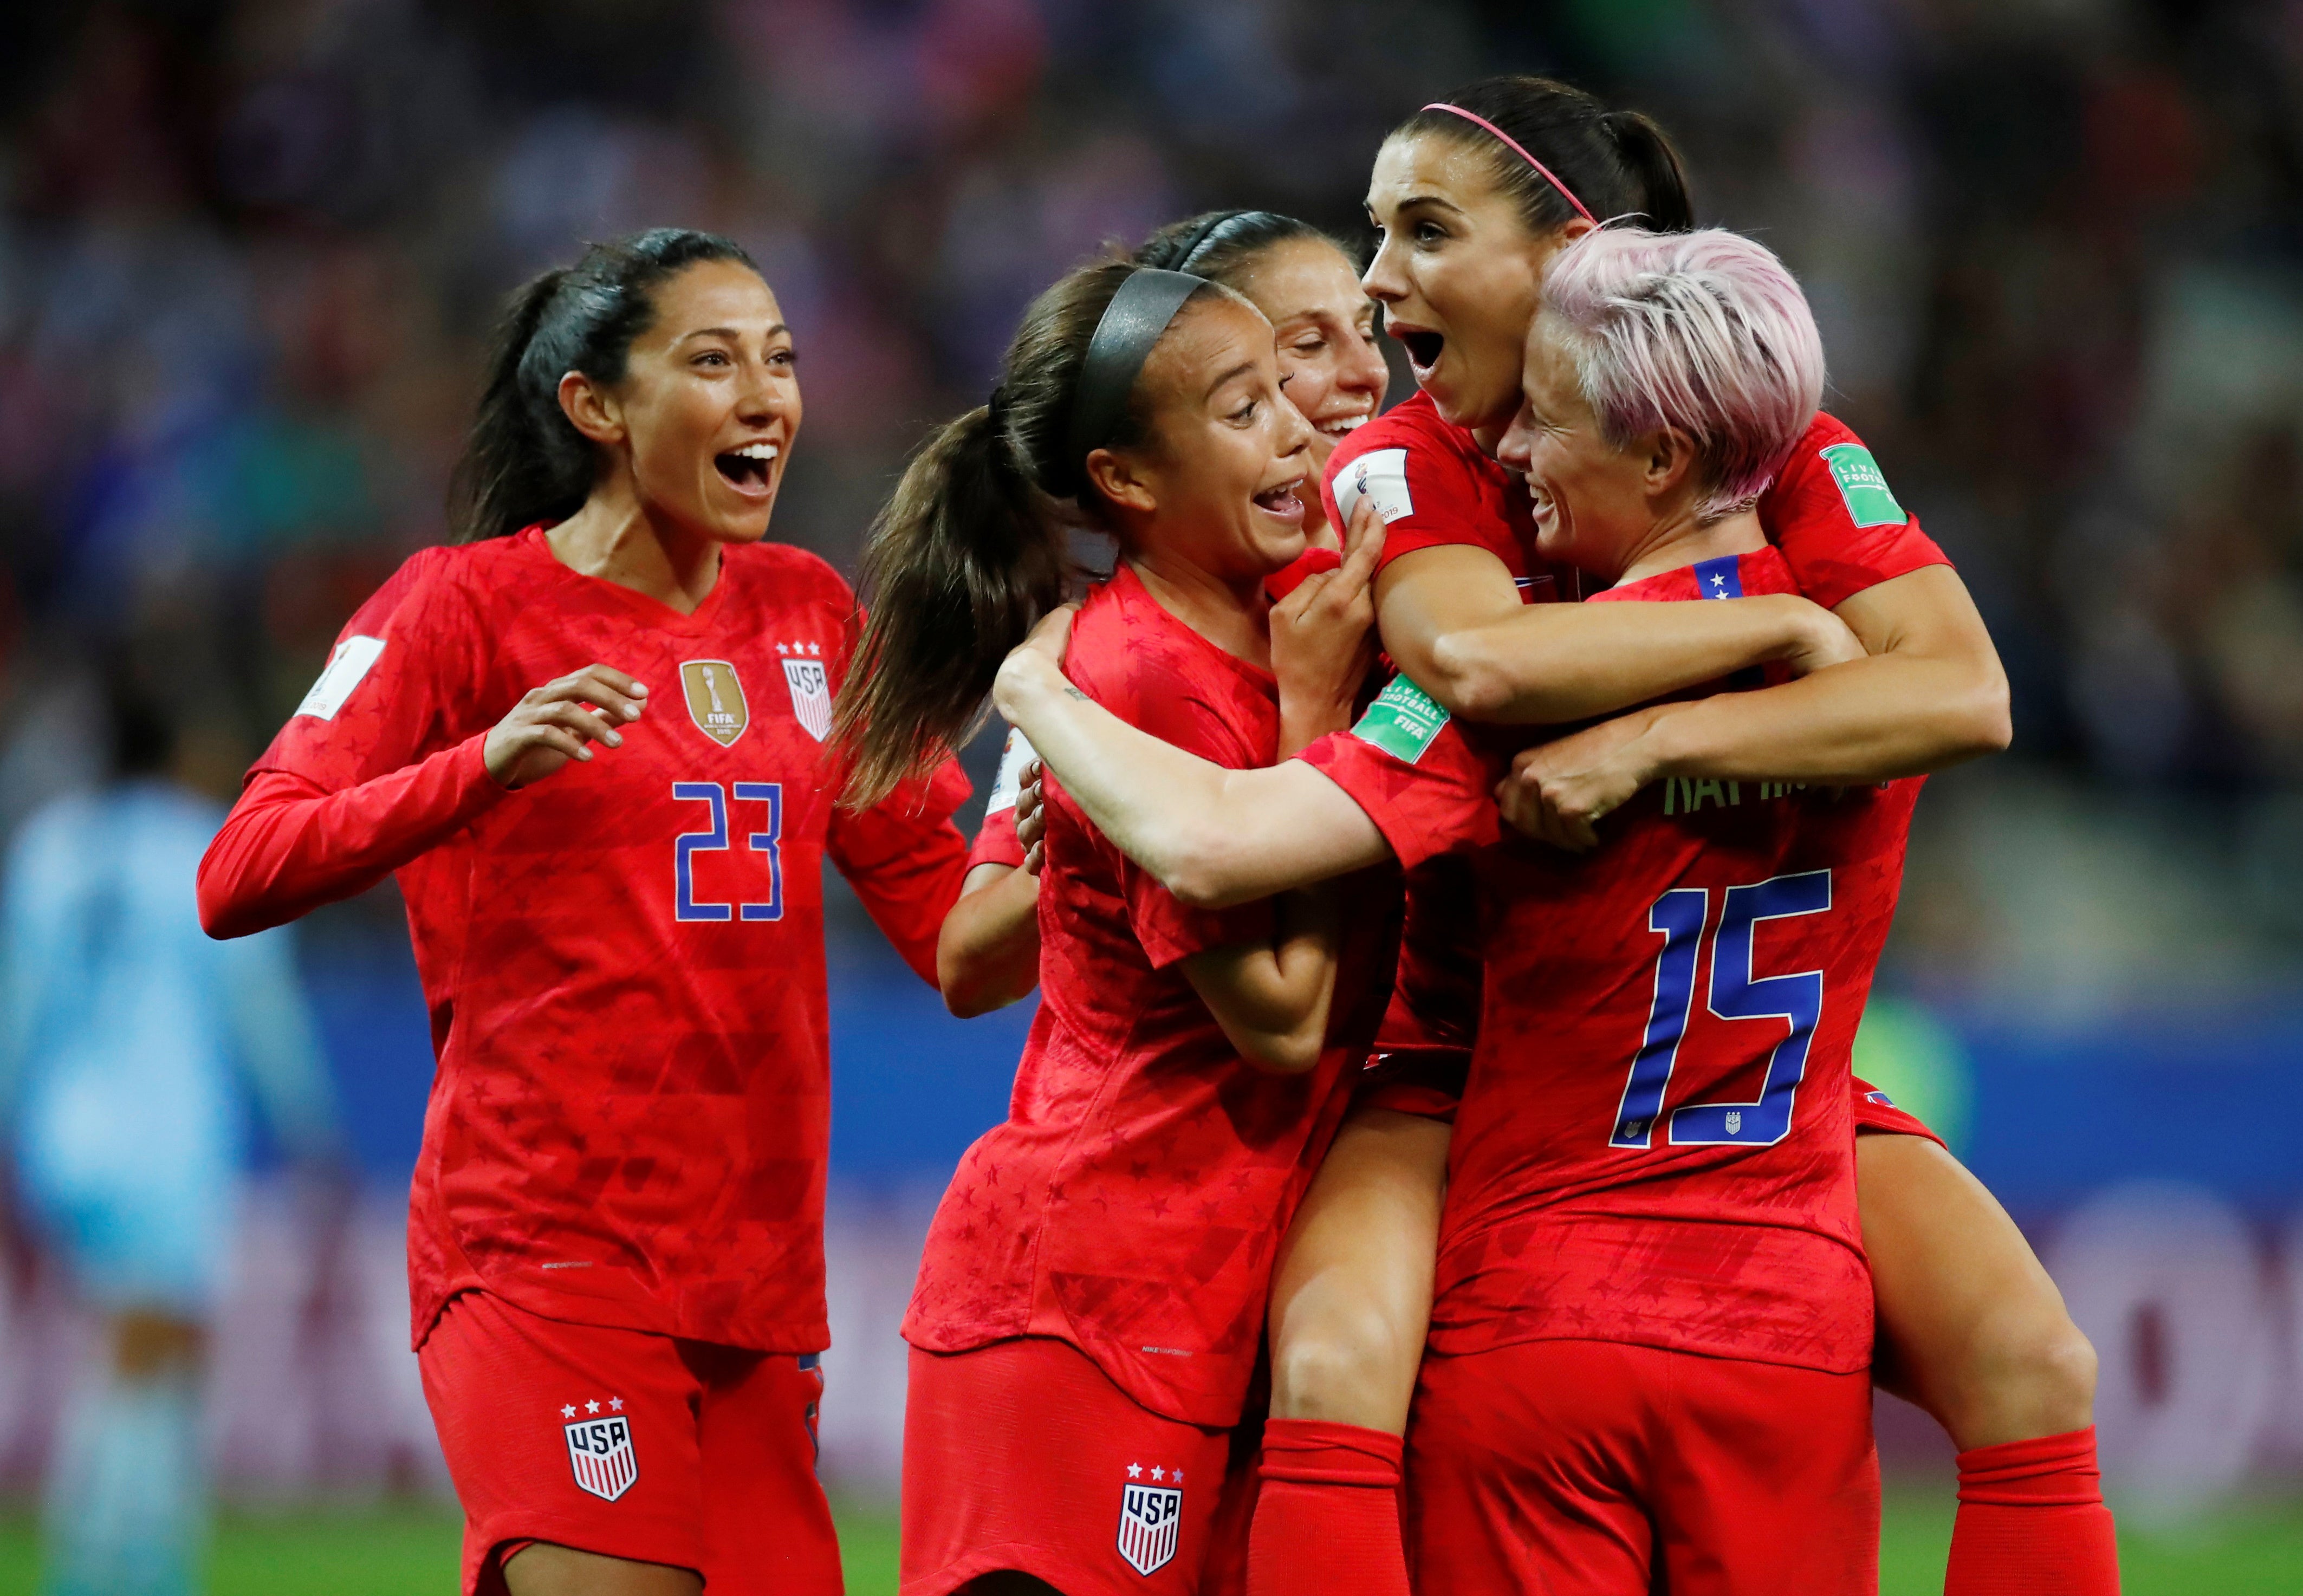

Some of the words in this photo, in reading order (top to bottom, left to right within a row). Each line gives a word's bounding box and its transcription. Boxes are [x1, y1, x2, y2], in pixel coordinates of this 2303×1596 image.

[1382, 507, 1398, 518] 019
[788, 665, 823, 694] USA
[707, 713, 734, 724] FIFA
[1381, 693, 1438, 721] FOOTBALL
[1393, 715, 1425, 740] FIFA
[672, 782, 783, 922] 23
[1608, 868, 1832, 1149] 15
[1727, 1116, 1740, 1124] USA
[570, 1422, 626, 1455] USA
[1128, 1490, 1178, 1526] USA
